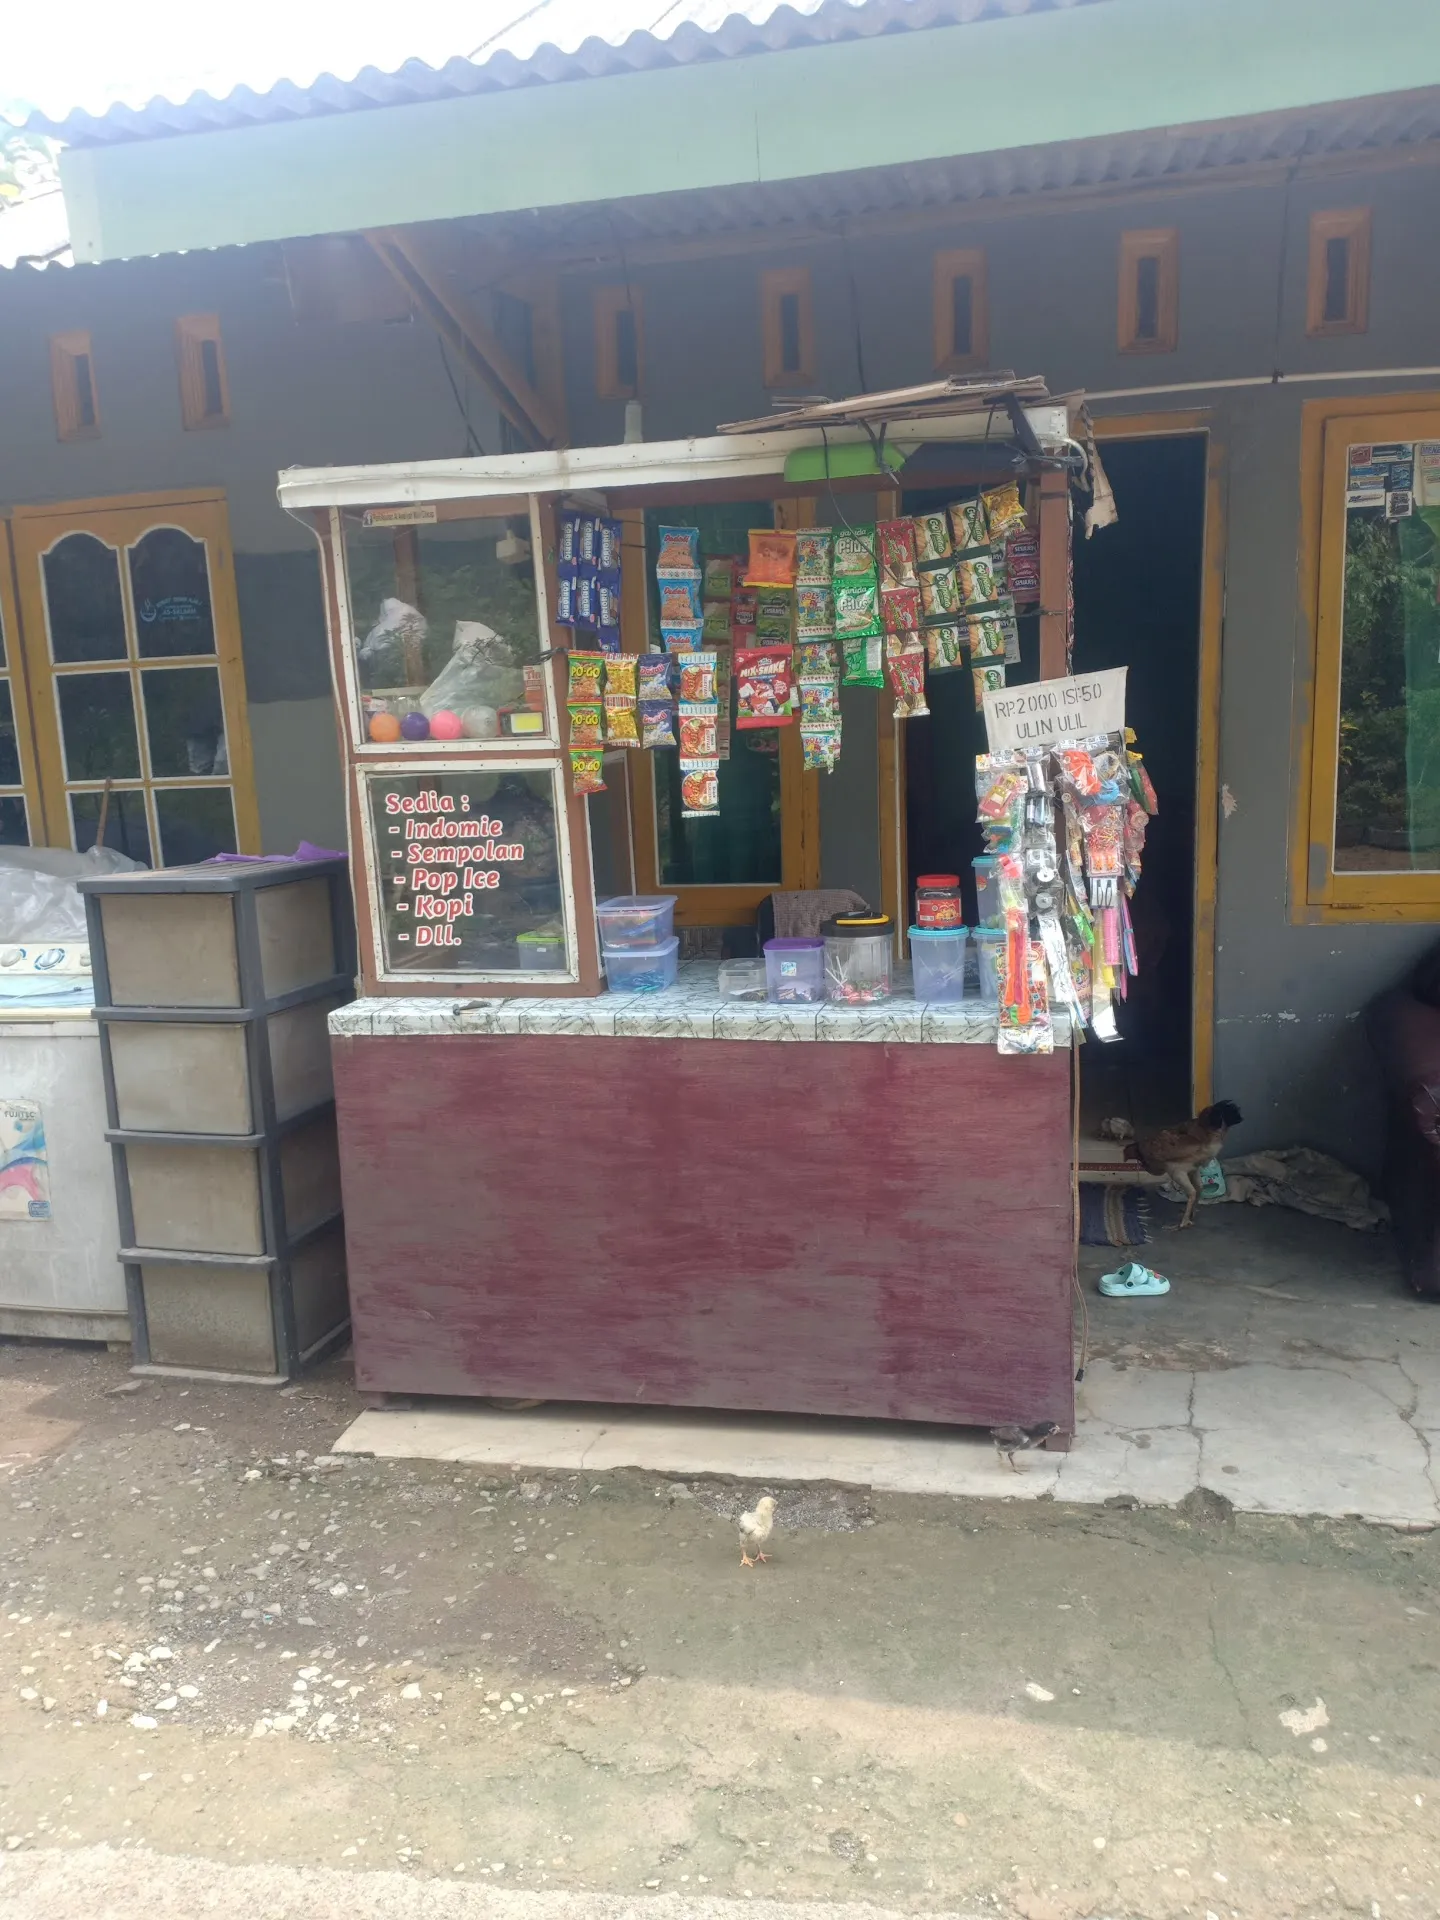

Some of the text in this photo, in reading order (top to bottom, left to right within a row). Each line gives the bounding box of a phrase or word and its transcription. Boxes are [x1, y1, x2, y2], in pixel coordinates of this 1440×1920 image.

[840, 599, 869, 611] Pilus
[1016, 712, 1088, 739] ULIN ULIL
[386, 790, 455, 814] Sedia
[405, 815, 503, 840] Indomie
[407, 840, 524, 867] Sempolan
[412, 868, 458, 895] Pop
[463, 867, 500, 889] Ice
[415, 892, 474, 921] Kopi
[416, 924, 462, 946] Dll.
